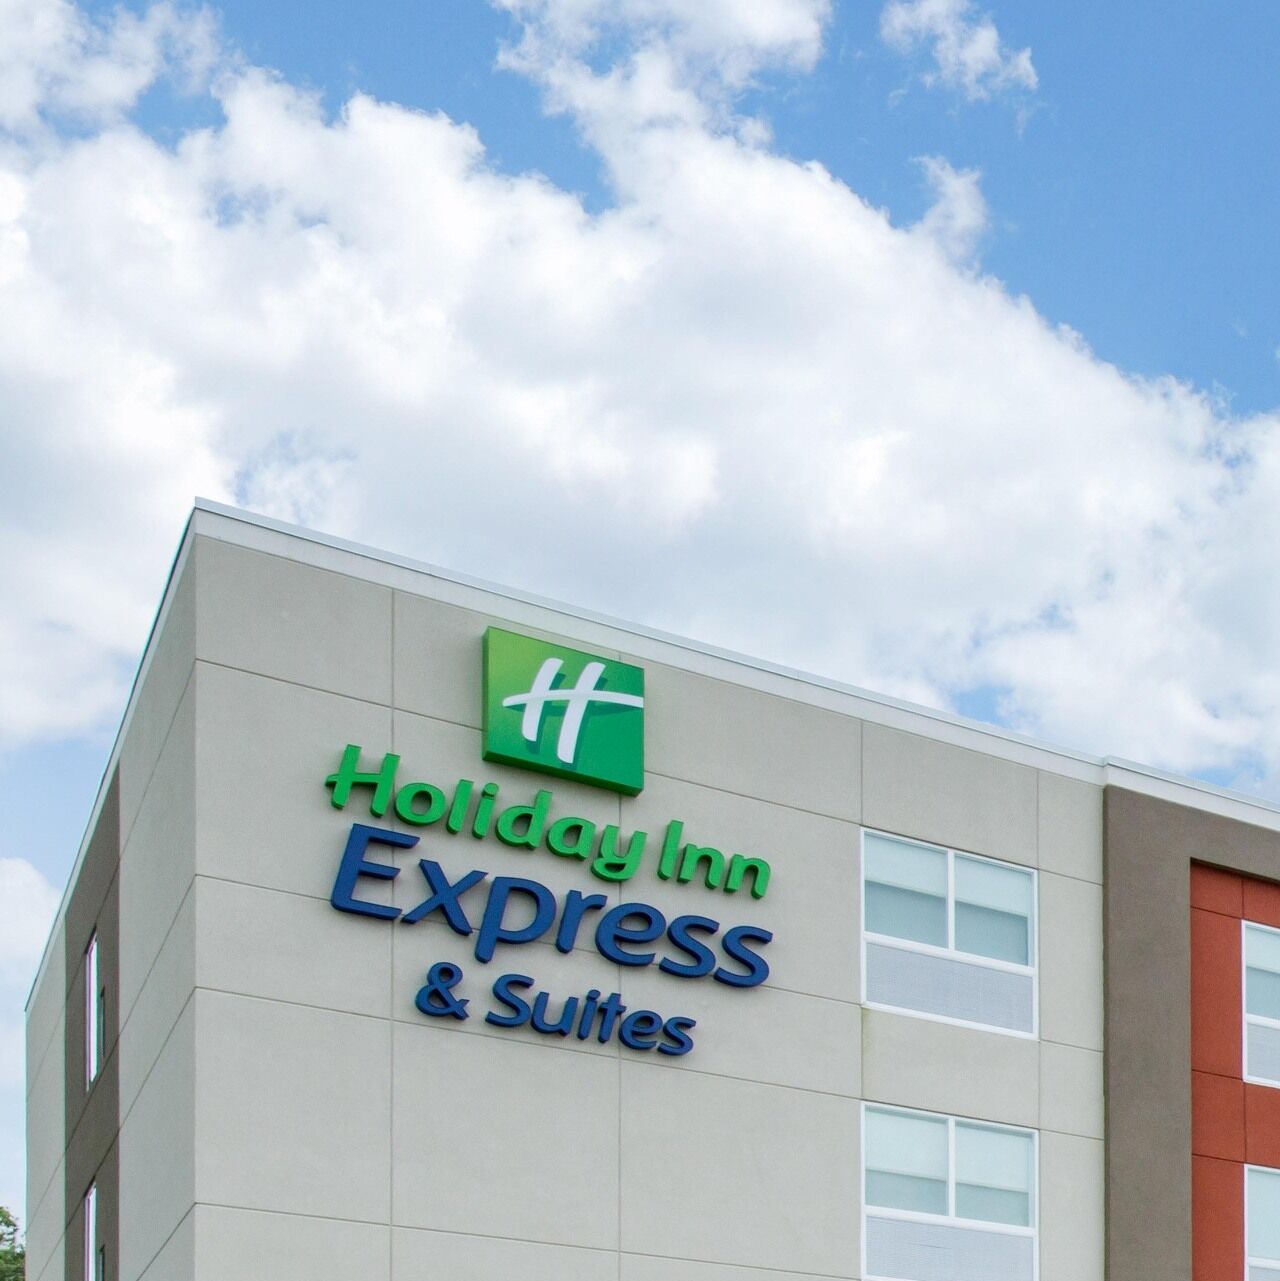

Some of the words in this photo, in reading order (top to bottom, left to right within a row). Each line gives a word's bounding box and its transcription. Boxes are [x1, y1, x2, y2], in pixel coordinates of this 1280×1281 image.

[325, 744, 647, 882] Holiday
[657, 819, 772, 899] Inn
[331, 822, 773, 988] Express
[415, 961, 470, 1021] &
[485, 973, 696, 1056] Suites
